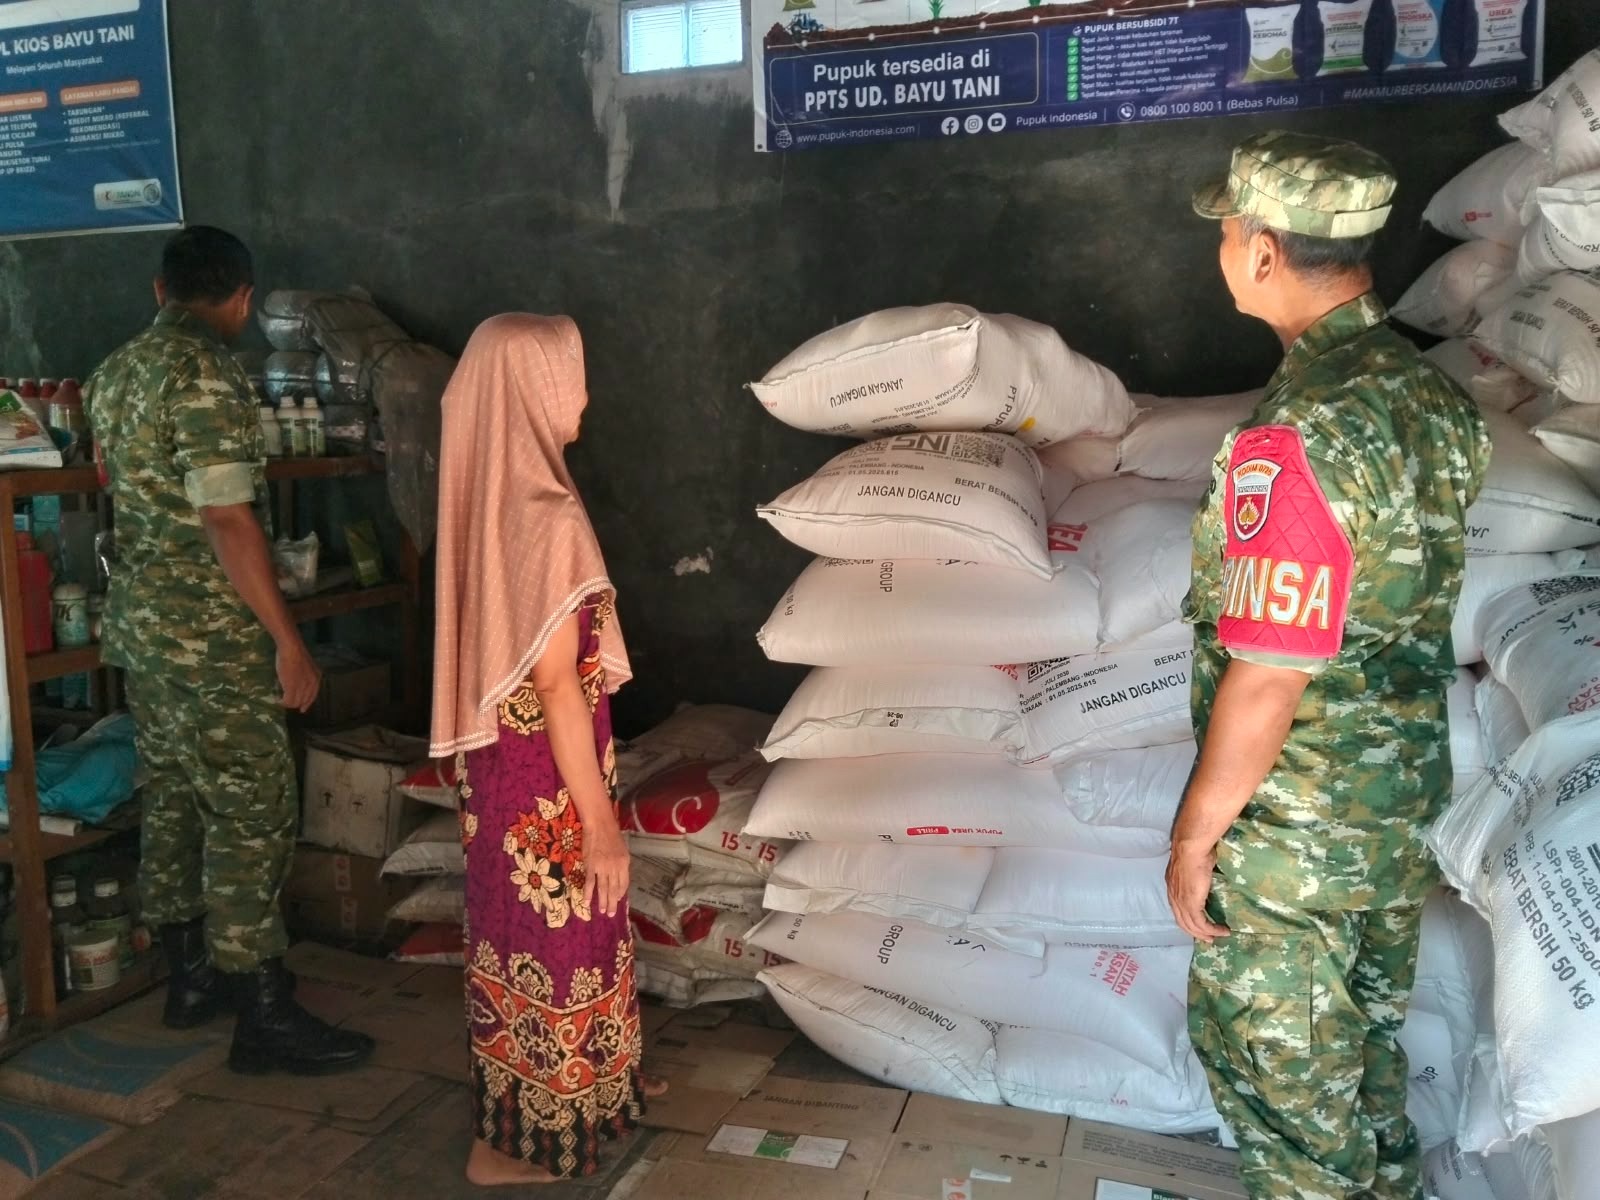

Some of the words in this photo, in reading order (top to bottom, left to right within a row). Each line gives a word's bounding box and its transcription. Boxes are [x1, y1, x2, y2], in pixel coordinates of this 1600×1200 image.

[1084, 24, 1114, 34] PUPUK
[1116, 18, 1166, 31] BERSUBSIDI
[1253, 30, 1288, 39] KEBOMAS
[14, 36, 50, 55] KIOS
[53, 29, 94, 50] BAYU
[98, 25, 135, 43] TANI
[6, 65, 36, 75] Melayani
[37, 60, 63, 71] Seluruh
[64, 55, 103, 68] Masyarakat
[813, 59, 877, 85] Pupuk
[882, 51, 964, 76] tersedia
[970, 48, 991, 68] di
[804, 89, 849, 113] PPTS
[855, 85, 888, 108] UD.
[894, 80, 946, 105] BAYU
[952, 75, 1000, 100] TANI
[1343, 75, 1518, 100] #MAKMURBERSAMAINDONESIA
[1140, 105, 1168, 117] 0800
[1170, 103, 1191, 115] 100
[1193, 102, 1214, 113] 800
[1226, 98, 1263, 111] (Bebas
[1266, 95, 1299, 107] Pulsa)
[1016, 115, 1047, 126] Pupuk
[1050, 110, 1098, 122] Indonesia
[796, 123, 915, 143] www.pupuk-indonesia.com
[830, 385, 868, 408] DIGANCU
[867, 378, 904, 396] JANGAN
[1007, 385, 1018, 402] PT
[892, 433, 951, 454] SNI
[1237, 463, 1258, 479] KODIM
[1258, 463, 1272, 477] 0725
[857, 485, 905, 498] JANGAN
[907, 487, 961, 506] DIGANCU
[954, 477, 986, 490] BERAT
[988, 484, 1020, 507] BERSIH
[879, 561, 894, 593] GROUP
[784, 604, 794, 617] kg
[1153, 651, 1187, 667] BERAT
[1045, 675, 1081, 694] PALEMBANG
[1083, 664, 1118, 679] INDONESIA
[1080, 689, 1128, 714] JANGAN
[1128, 672, 1187, 699] DIGANCU
[721, 831, 739, 851] 15
[757, 841, 778, 862] 15
[793, 917, 803, 928] 50
[1503, 842, 1527, 891] BERAT
[1517, 887, 1561, 959] BERSIH
[1551, 955, 1577, 982] 50
[1568, 978, 1596, 1010] kg
[1532, 861, 1600, 977] 1-104-011-2500
[787, 930, 799, 941] kg
[877, 924, 904, 965] GROUP
[724, 938, 743, 958] 15
[907, 1001, 958, 1032] DIGANCU
[764, 1095, 801, 1106] JANGAN
